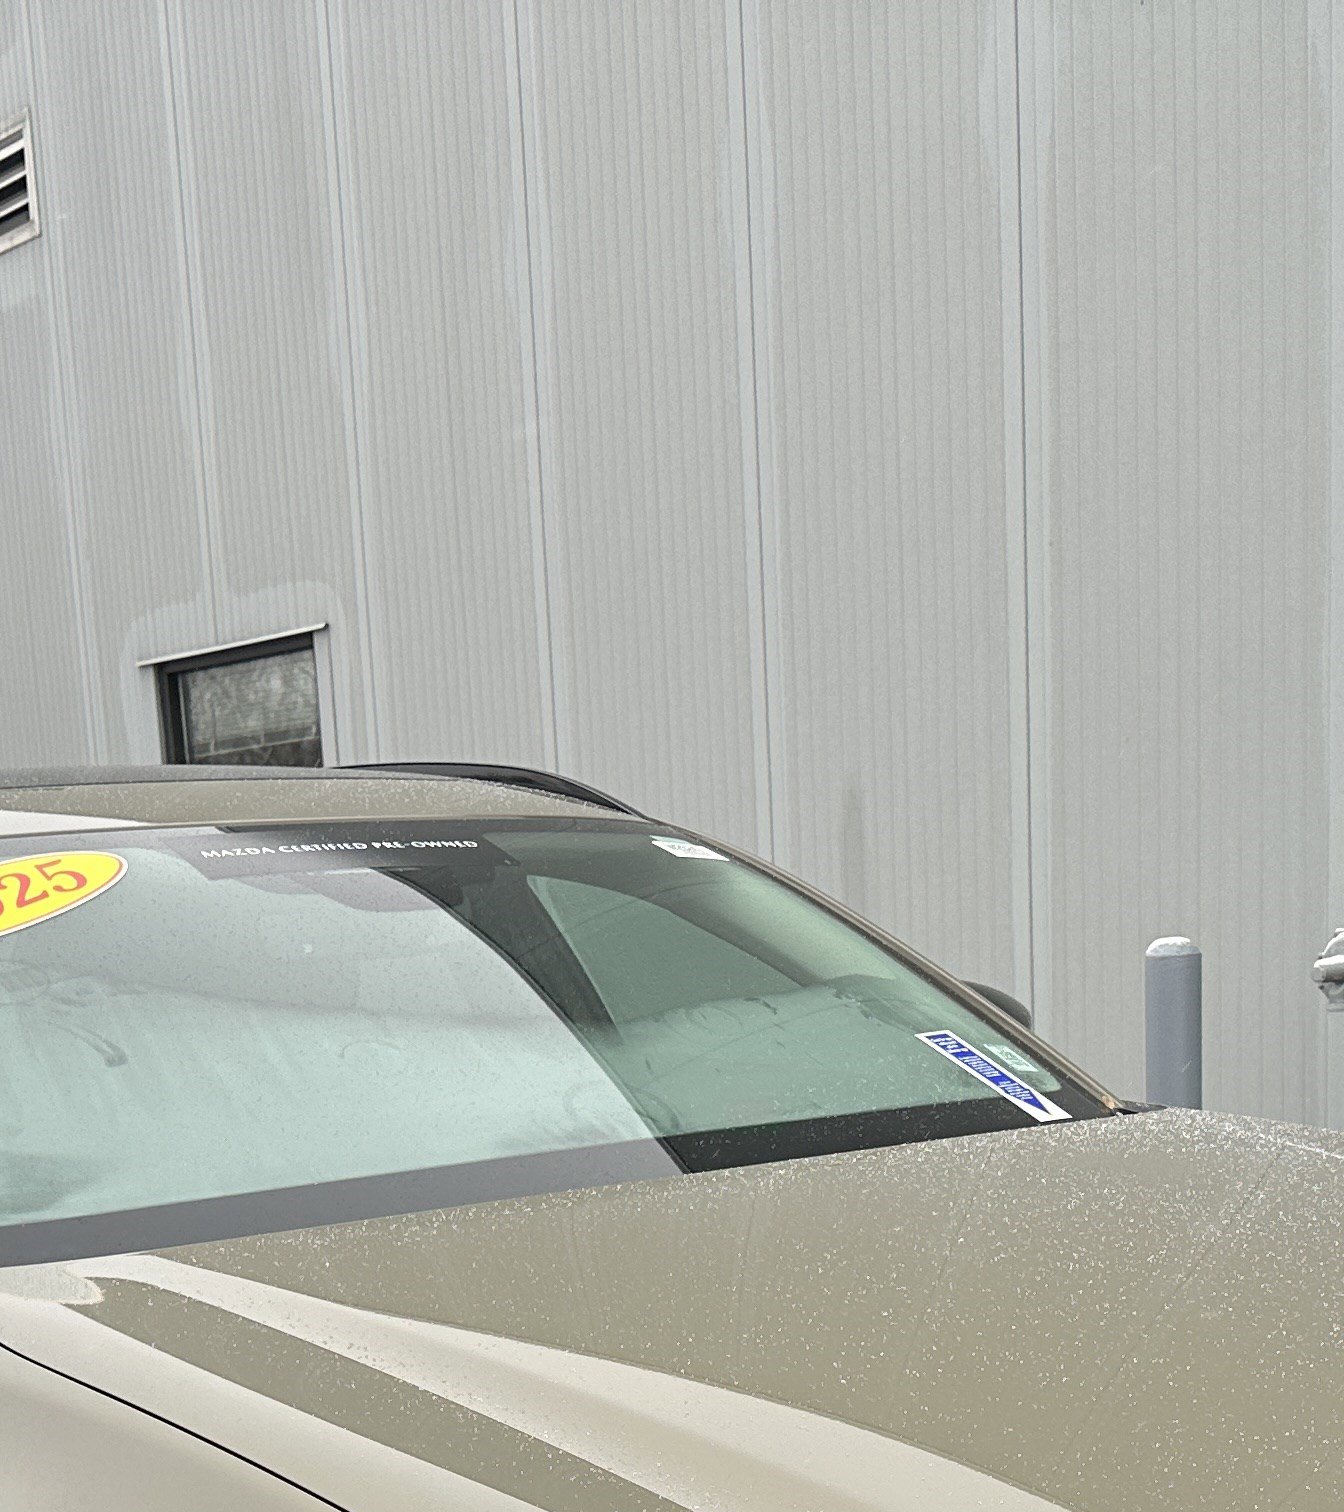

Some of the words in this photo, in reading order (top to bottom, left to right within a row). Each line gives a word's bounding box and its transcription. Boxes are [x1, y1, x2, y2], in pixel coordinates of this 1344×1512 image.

[200, 845, 276, 859] MAZDA
[278, 841, 368, 854] CERTIFIED
[371, 839, 478, 851] PRE-OWNED
